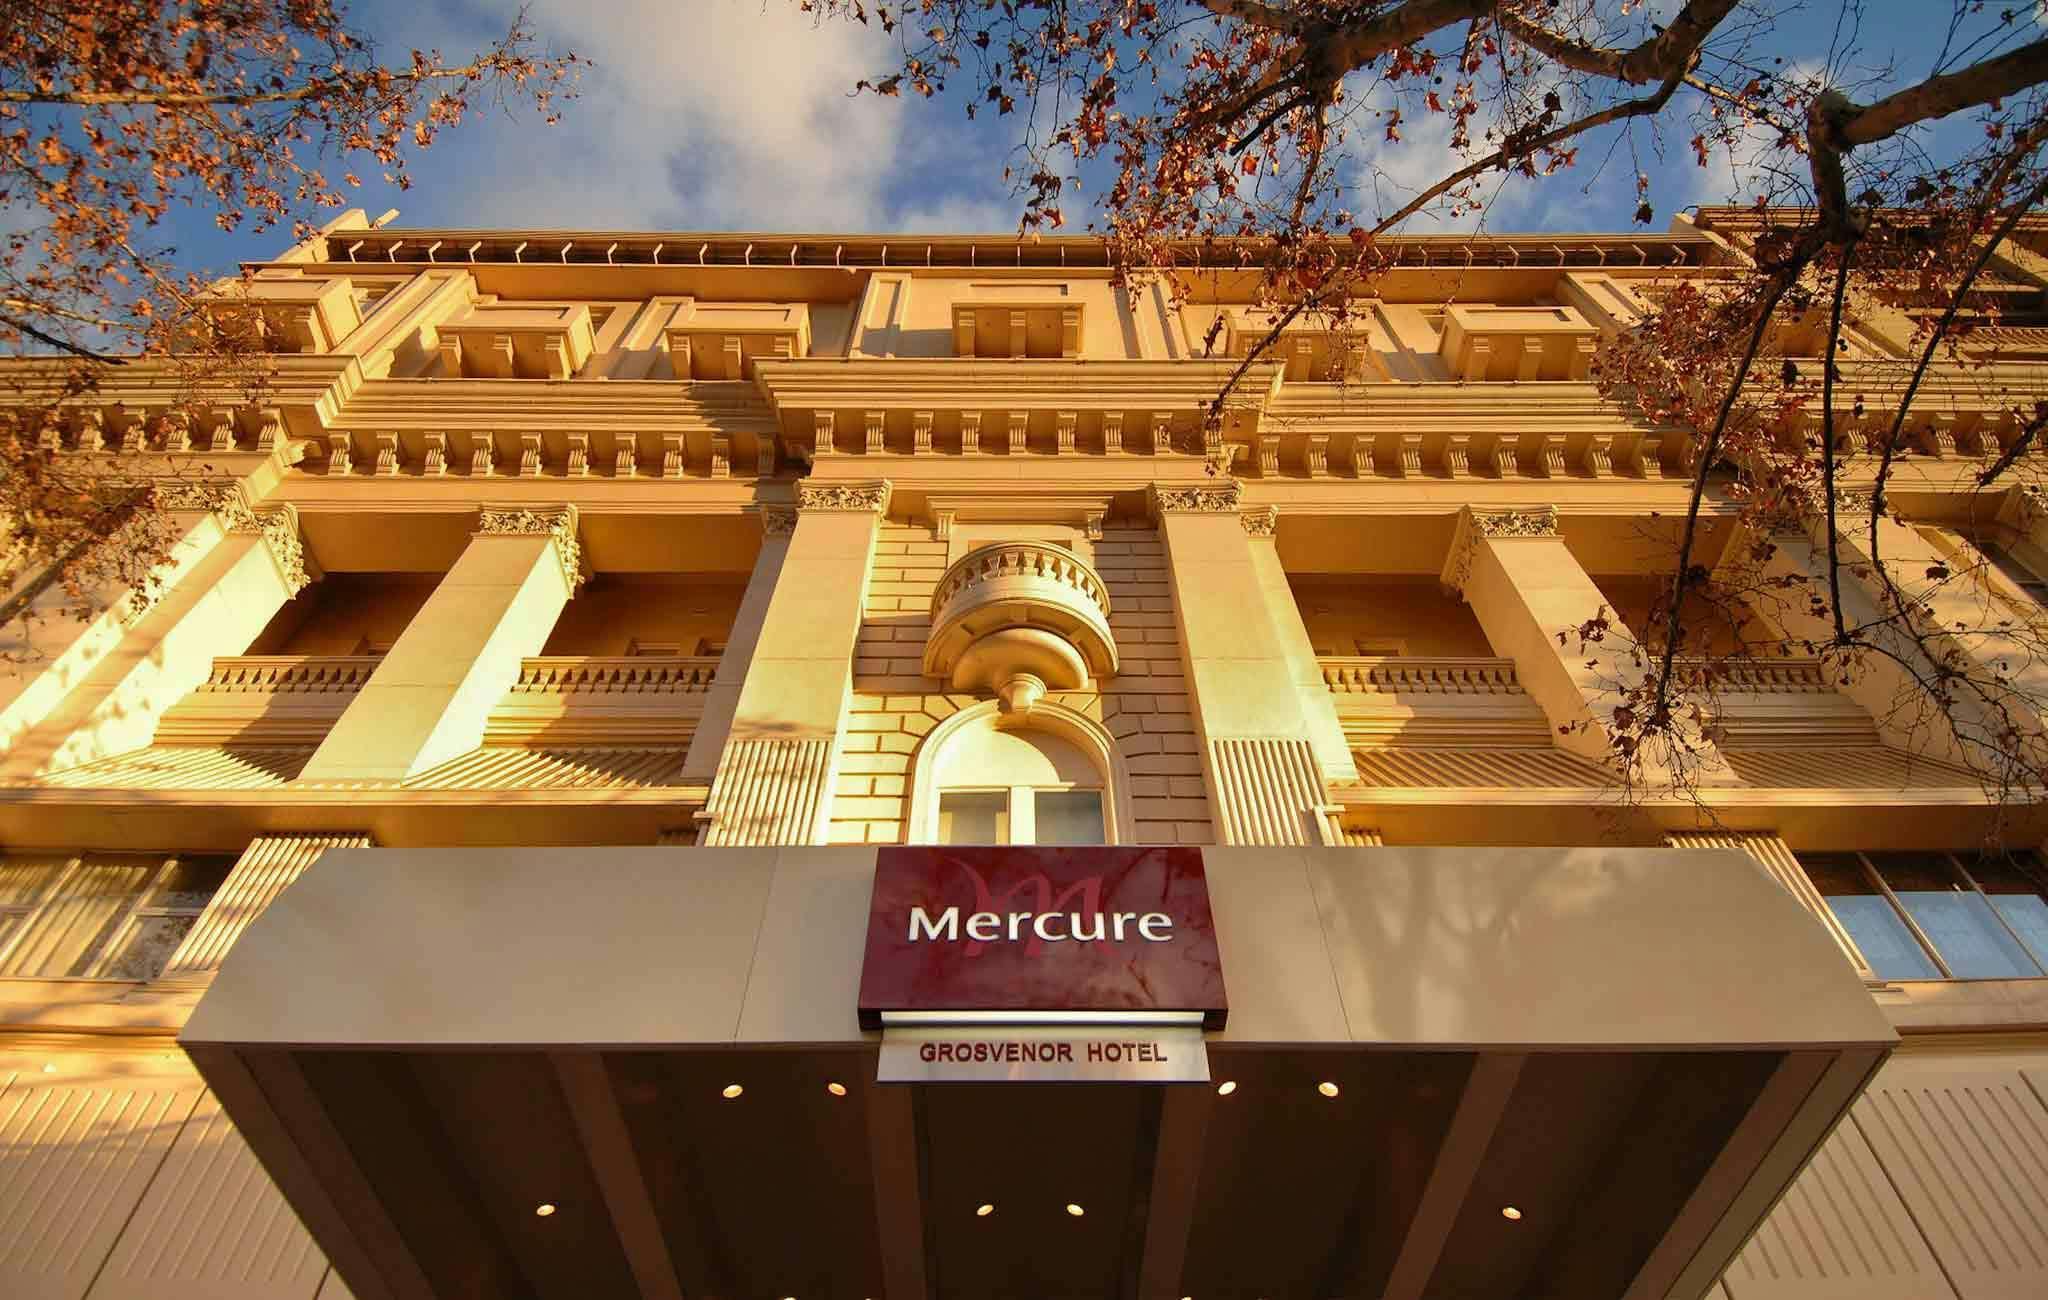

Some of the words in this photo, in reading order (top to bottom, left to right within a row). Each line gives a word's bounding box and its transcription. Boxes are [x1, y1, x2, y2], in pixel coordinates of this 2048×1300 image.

[908, 906, 1174, 942] Mercure
[919, 1042, 1073, 1063] GROSVENOR
[1087, 1042, 1168, 1063] HOTEL
